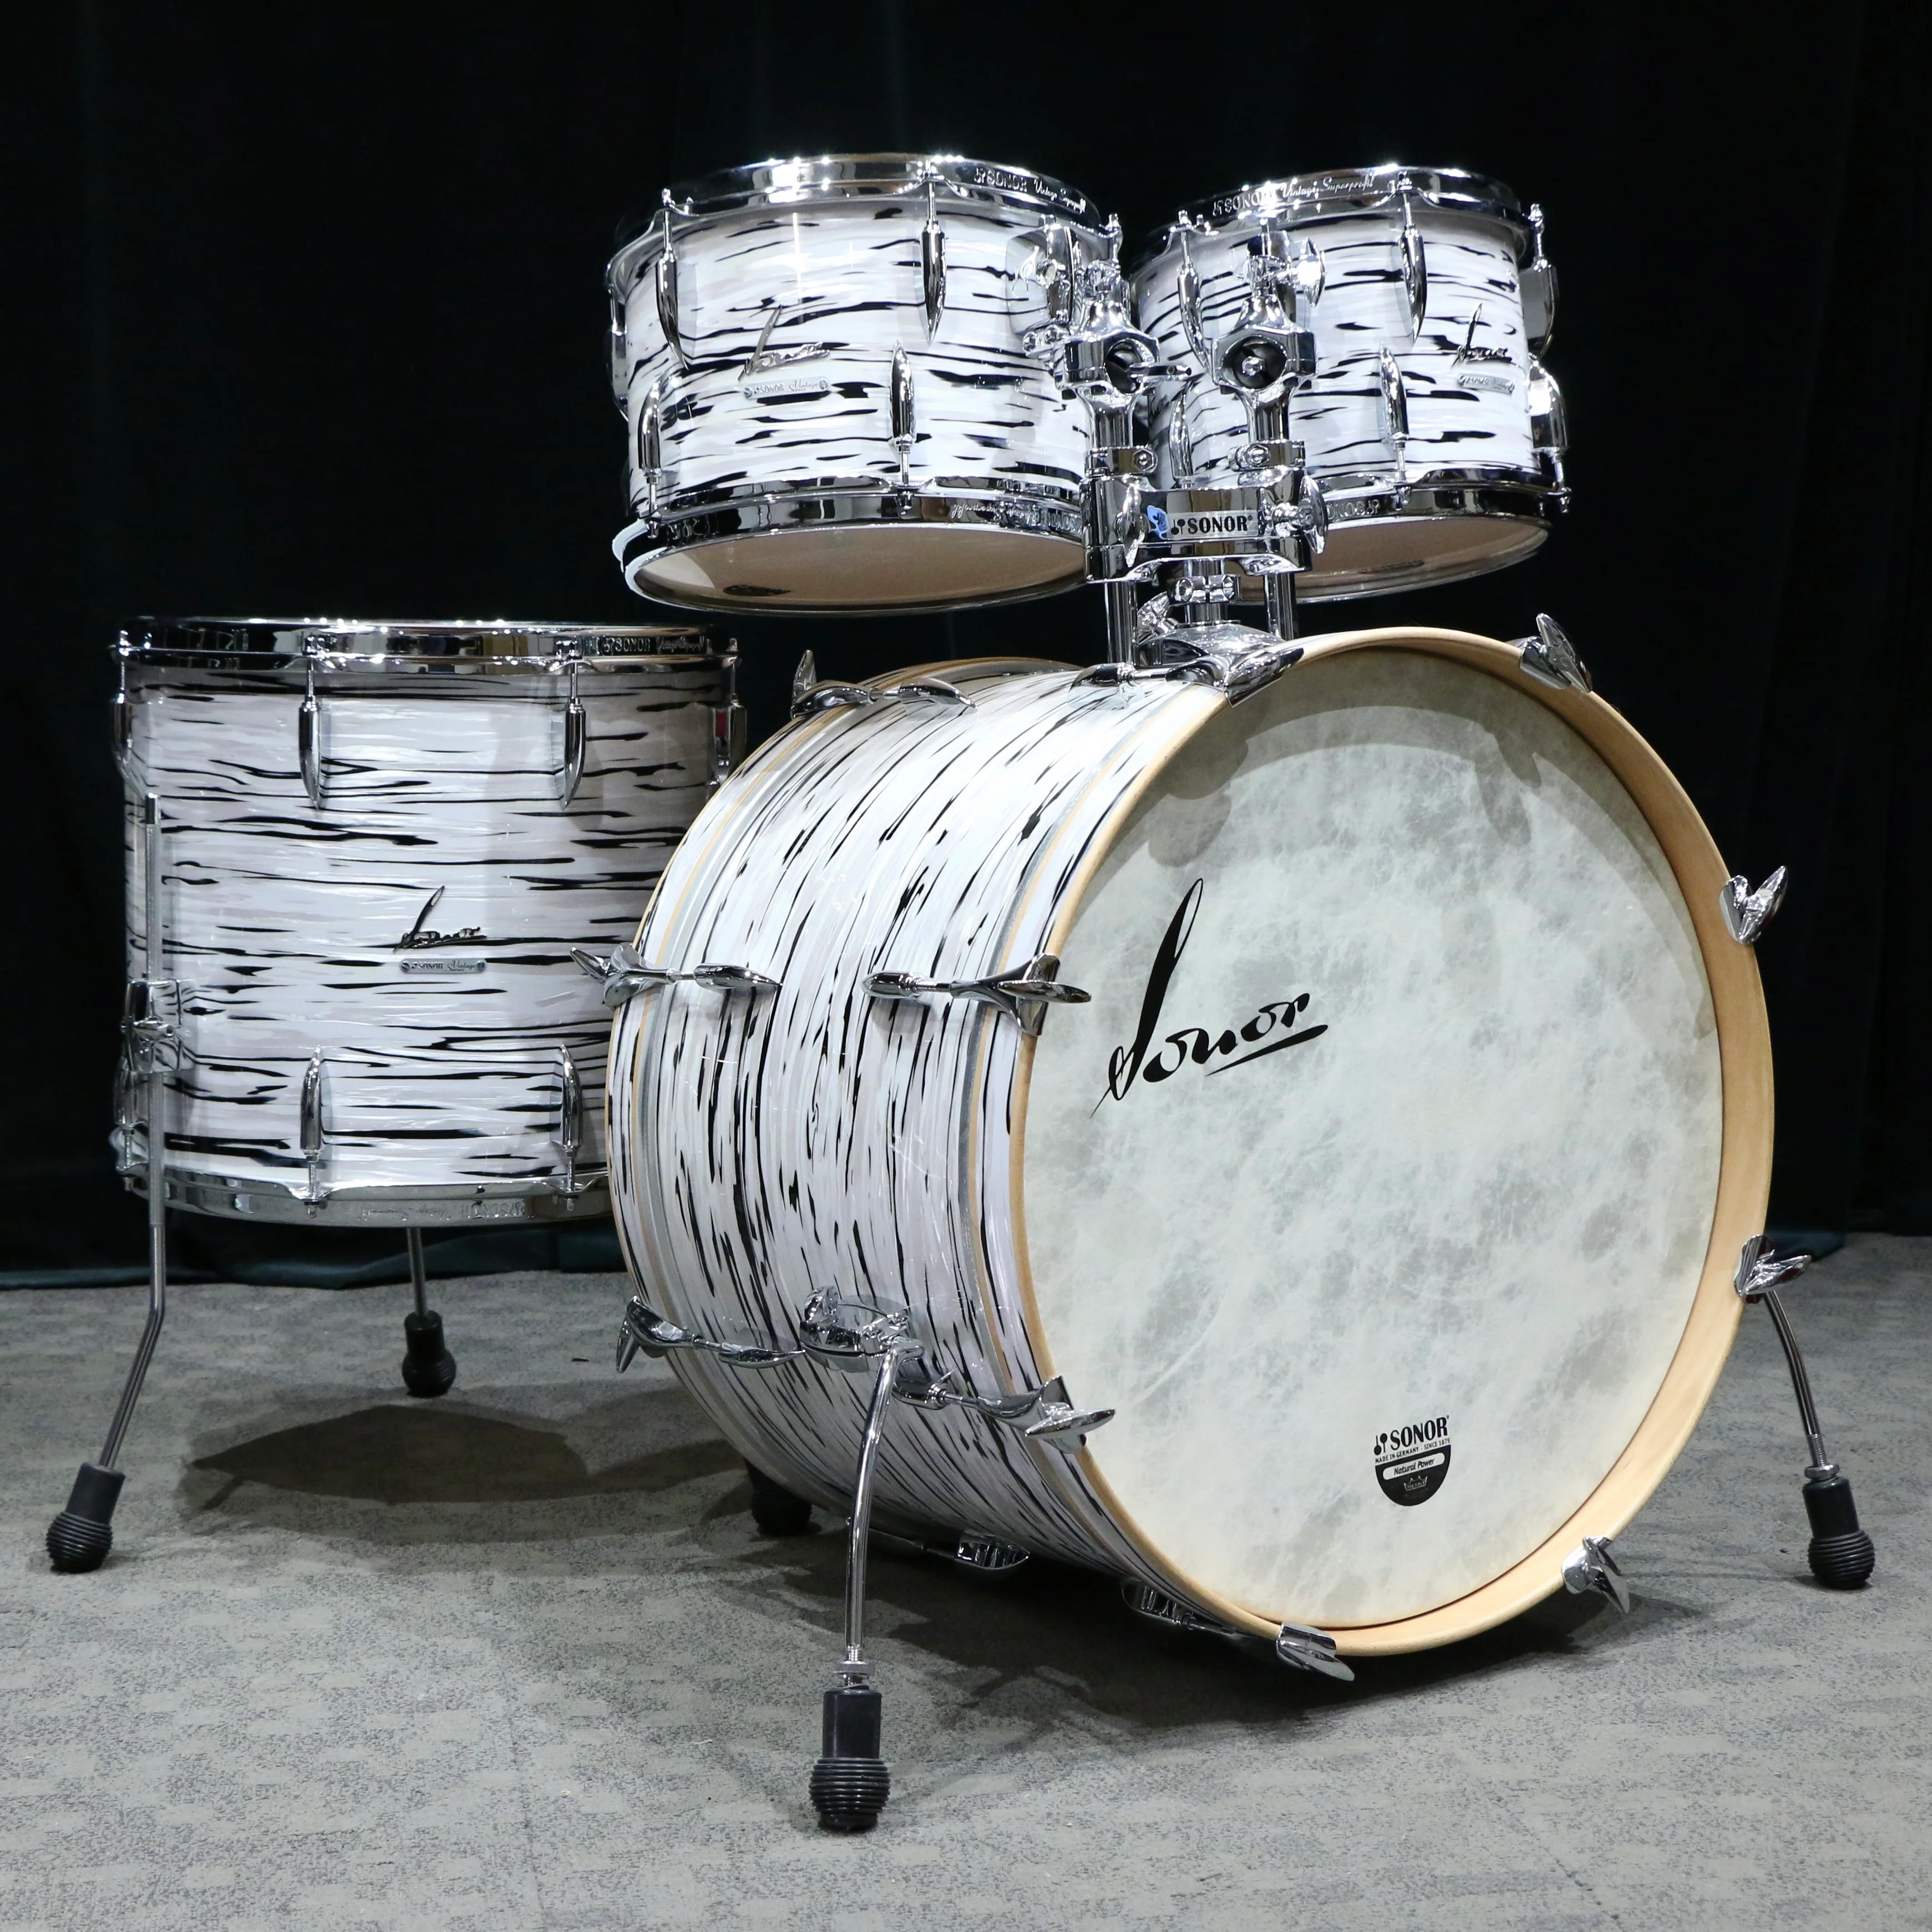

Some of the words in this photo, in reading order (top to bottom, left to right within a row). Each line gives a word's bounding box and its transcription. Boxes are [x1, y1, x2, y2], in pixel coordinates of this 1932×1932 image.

[986, 170, 1027, 192] SONOR
[1224, 187, 1275, 213] SONO
[1322, 173, 1376, 194] Superprofil
[1188, 515, 1249, 535] SONOR
[450, 960, 476, 969] Vintage
[1089, 878, 1328, 1119] Sonor
[1390, 1417, 1448, 1451] SONOR
[1396, 1447, 1419, 1458] GERMANY
[1424, 1442, 1438, 1451] SINCE
[1439, 1438, 1451, 1446] 1875
[1394, 1462, 1416, 1475] Natural
[1417, 1458, 1435, 1469] Power
